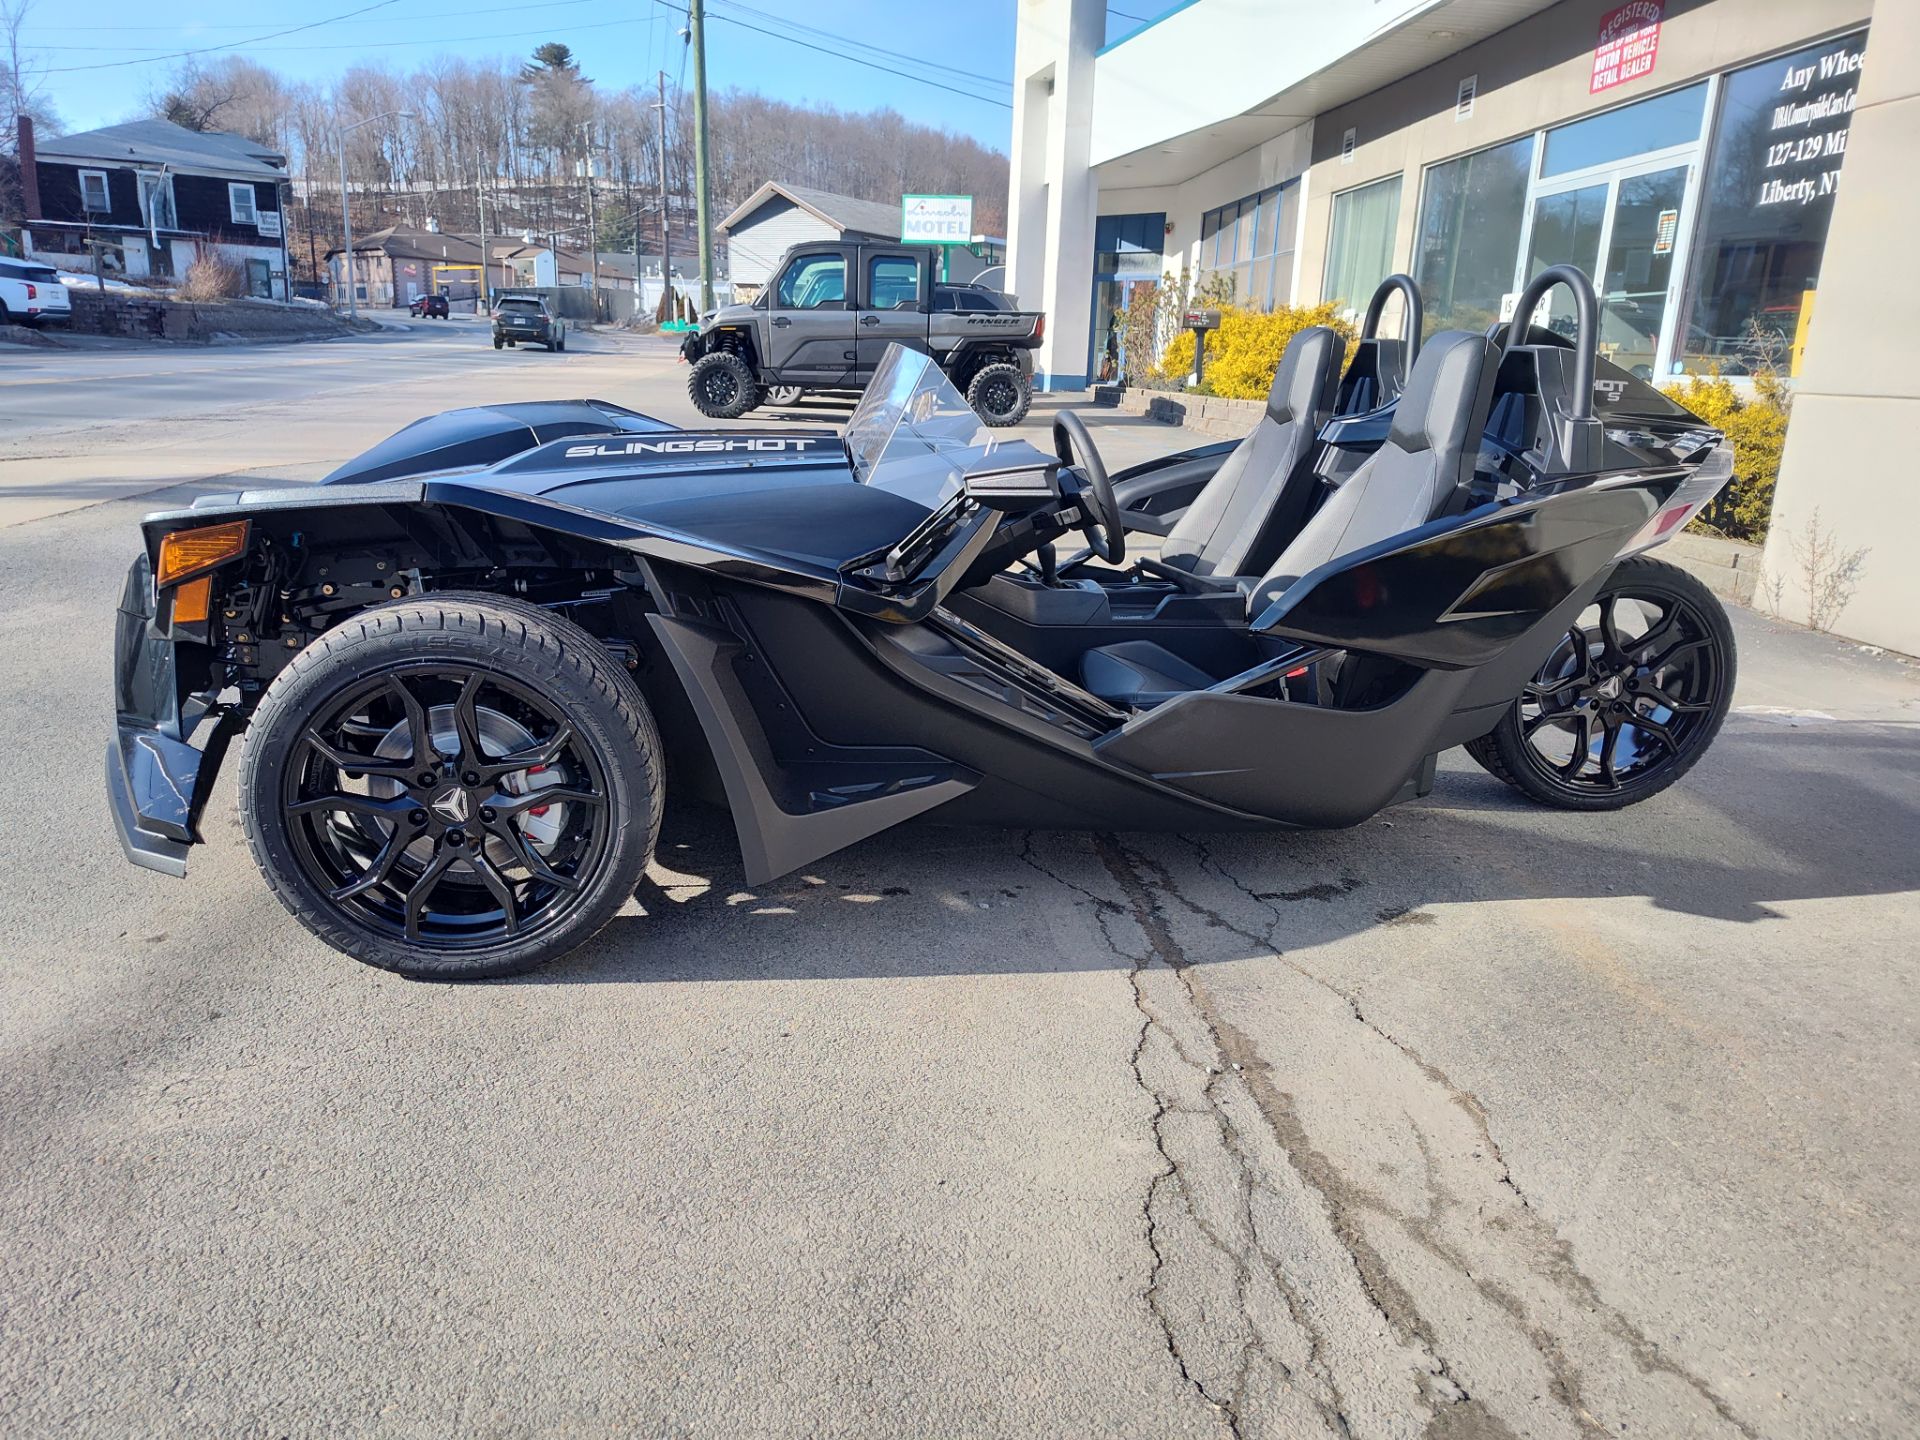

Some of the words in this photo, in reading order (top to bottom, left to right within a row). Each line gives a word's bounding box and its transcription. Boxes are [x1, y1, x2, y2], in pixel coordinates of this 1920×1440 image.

[1600, 1, 1660, 44] REGISTERED
[1597, 42, 1614, 55] STATE
[1615, 38, 1624, 48] OF
[1624, 31, 1639, 44] NEW
[1640, 23, 1657, 37] YORK
[1593, 49, 1621, 73] MOTOR
[1622, 34, 1657, 62] VEHICLE
[1592, 66, 1618, 91] RETAIL
[1619, 54, 1652, 81] DEALER
[1780, 65, 1816, 91] Any
[1771, 105, 1789, 130] DBA
[1766, 135, 1822, 168] 127-129
[1759, 178, 1816, 206] Liberty,
[906, 200, 969, 217] Lincoln
[906, 220, 969, 234] MOTEL
[1607, 392, 1622, 402] S
[565, 439, 817, 458] SLINGSHOT
